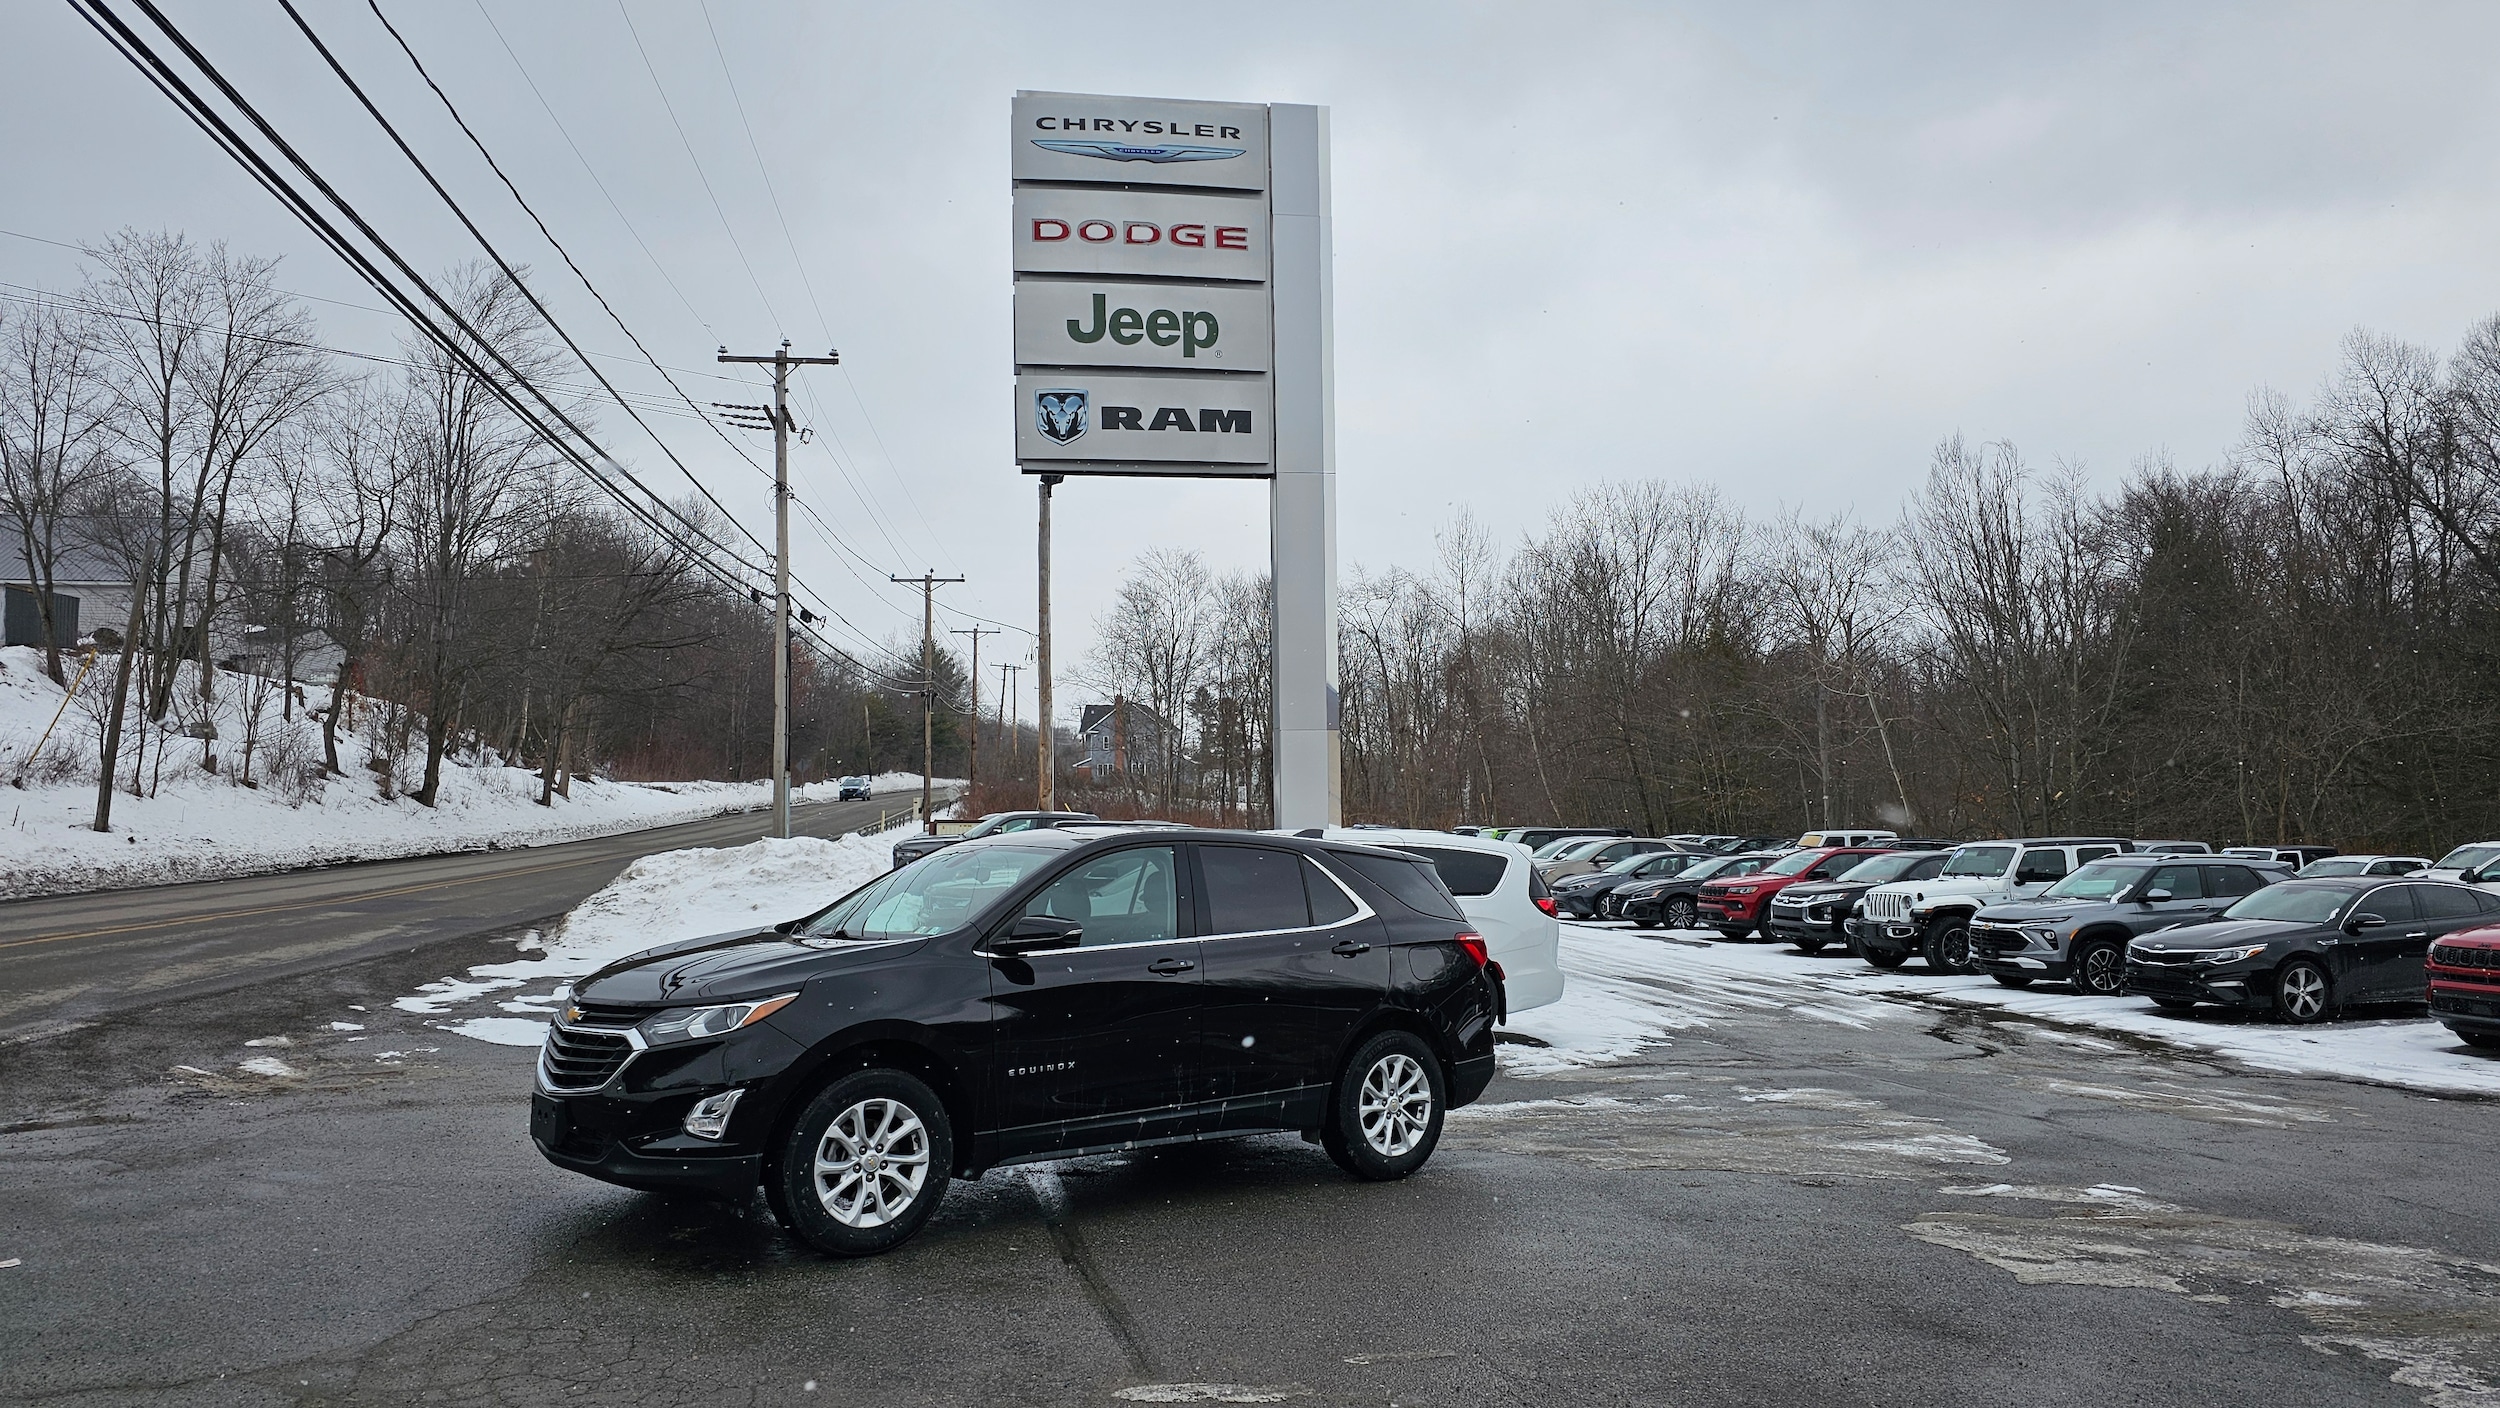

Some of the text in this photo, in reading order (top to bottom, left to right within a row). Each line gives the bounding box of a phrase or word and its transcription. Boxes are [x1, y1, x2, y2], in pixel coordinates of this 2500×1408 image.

[1035, 116, 1241, 140] CHRYSLER
[1032, 218, 1249, 251] DODGE
[1066, 293, 1219, 358] Jeep
[1101, 406, 1251, 434] RAM
[1008, 1061, 1075, 1077] EQUINOX
